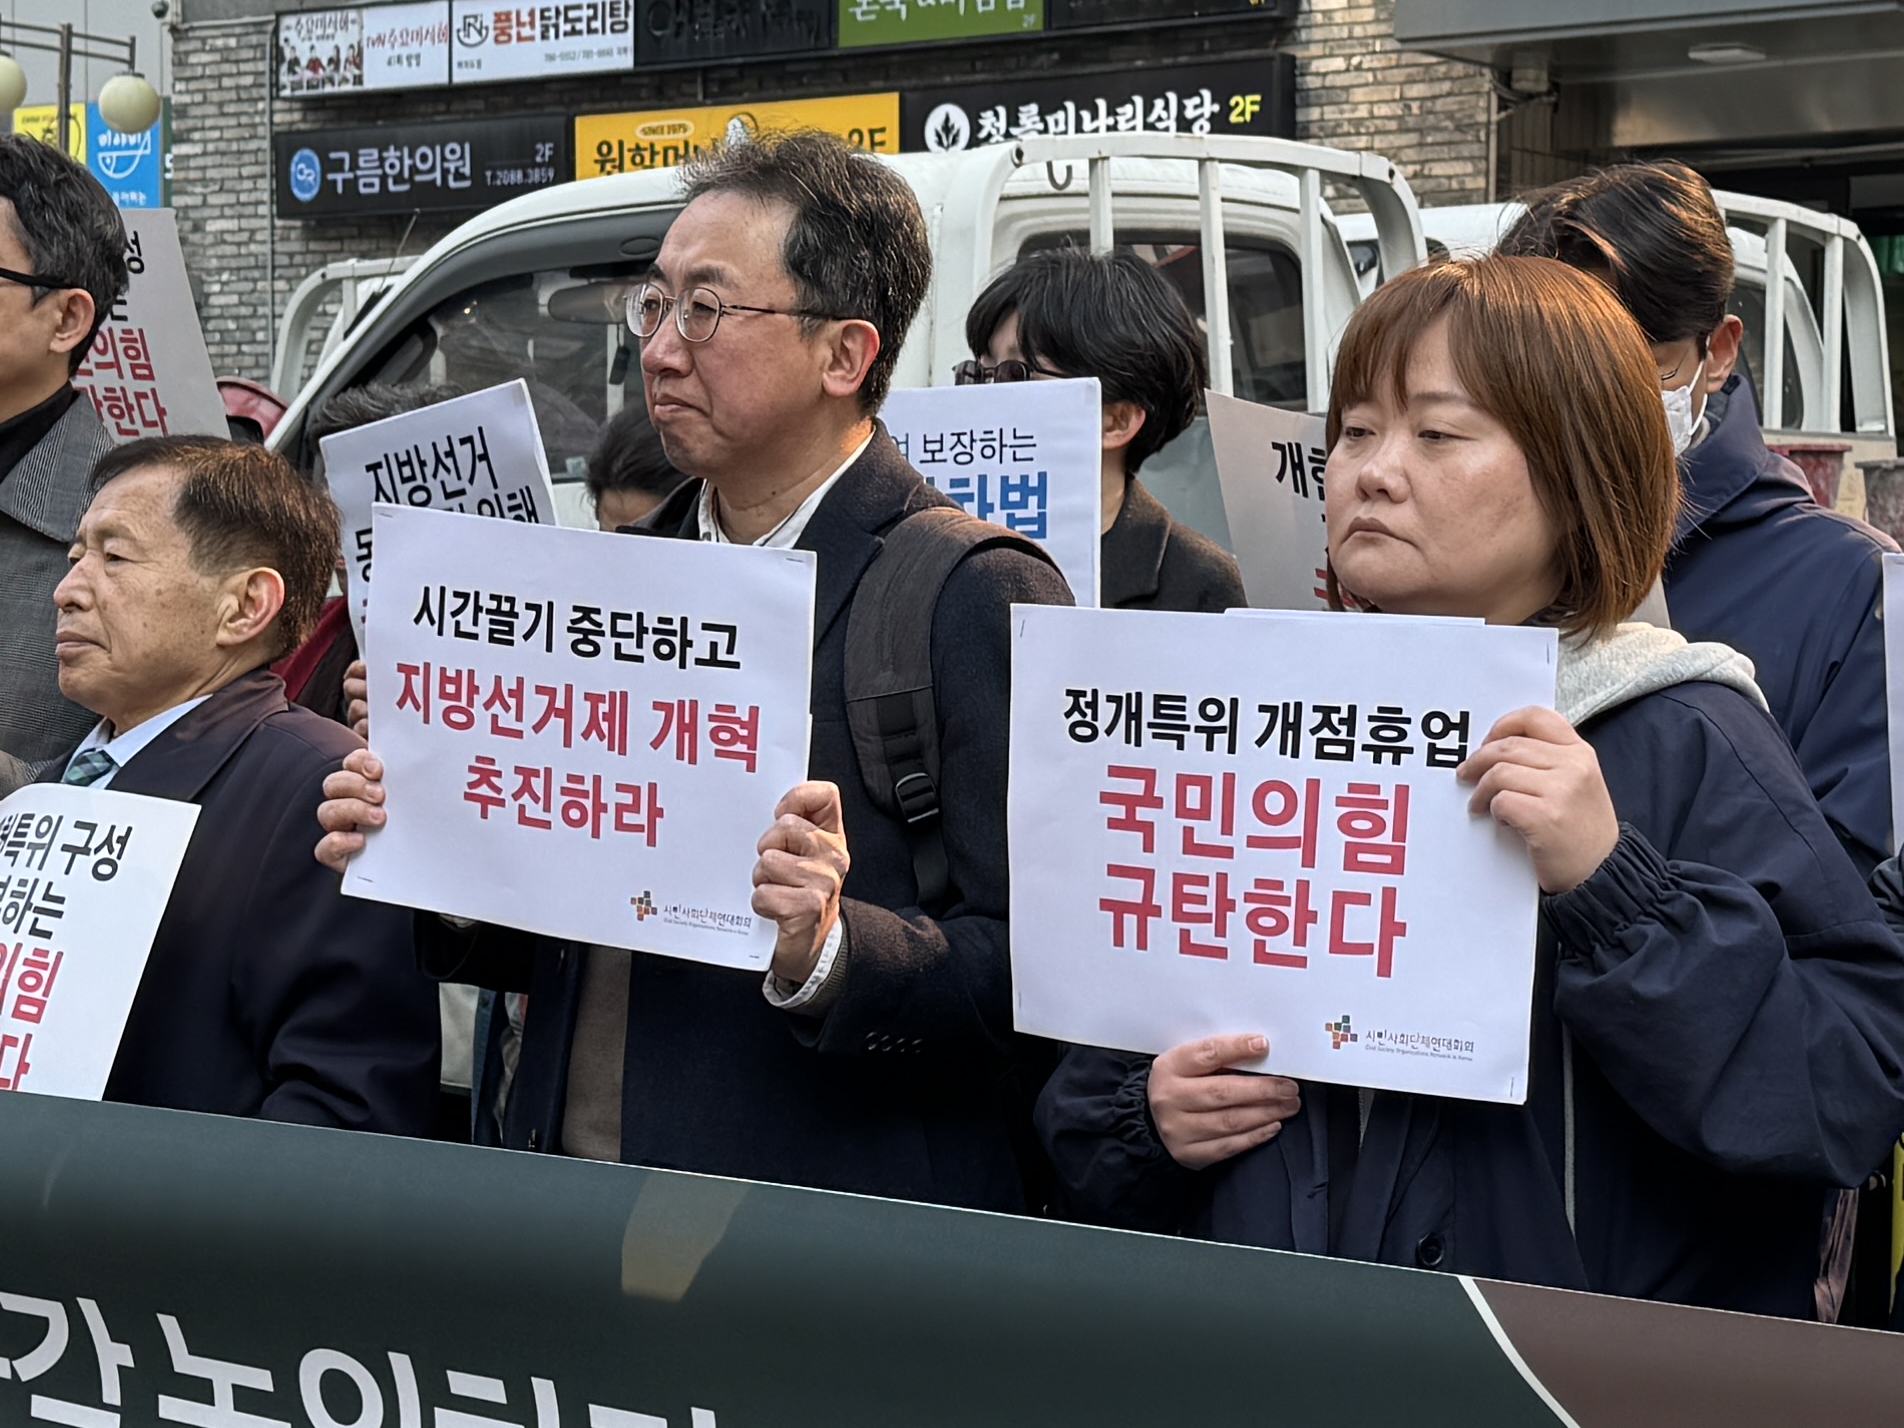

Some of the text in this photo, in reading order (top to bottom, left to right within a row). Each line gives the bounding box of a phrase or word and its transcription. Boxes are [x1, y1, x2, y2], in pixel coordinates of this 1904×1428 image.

[1228, 94, 1262, 123] 2F
[327, 141, 472, 194] 구름한의원
[535, 143, 554, 163] 2F
[365, 425, 499, 508] 지방선거
[919, 427, 1037, 466] 보장하는
[412, 584, 743, 673] 시간끌기 중단하고
[394, 660, 763, 775] 지방선거제 개혁
[1062, 687, 1471, 770] 정개특위 개점휴업
[462, 753, 666, 849] 추진하라
[1098, 763, 1413, 877] 국민의힘
[60, 819, 134, 882] 구성
[1098, 862, 1408, 980] 규탄한다
